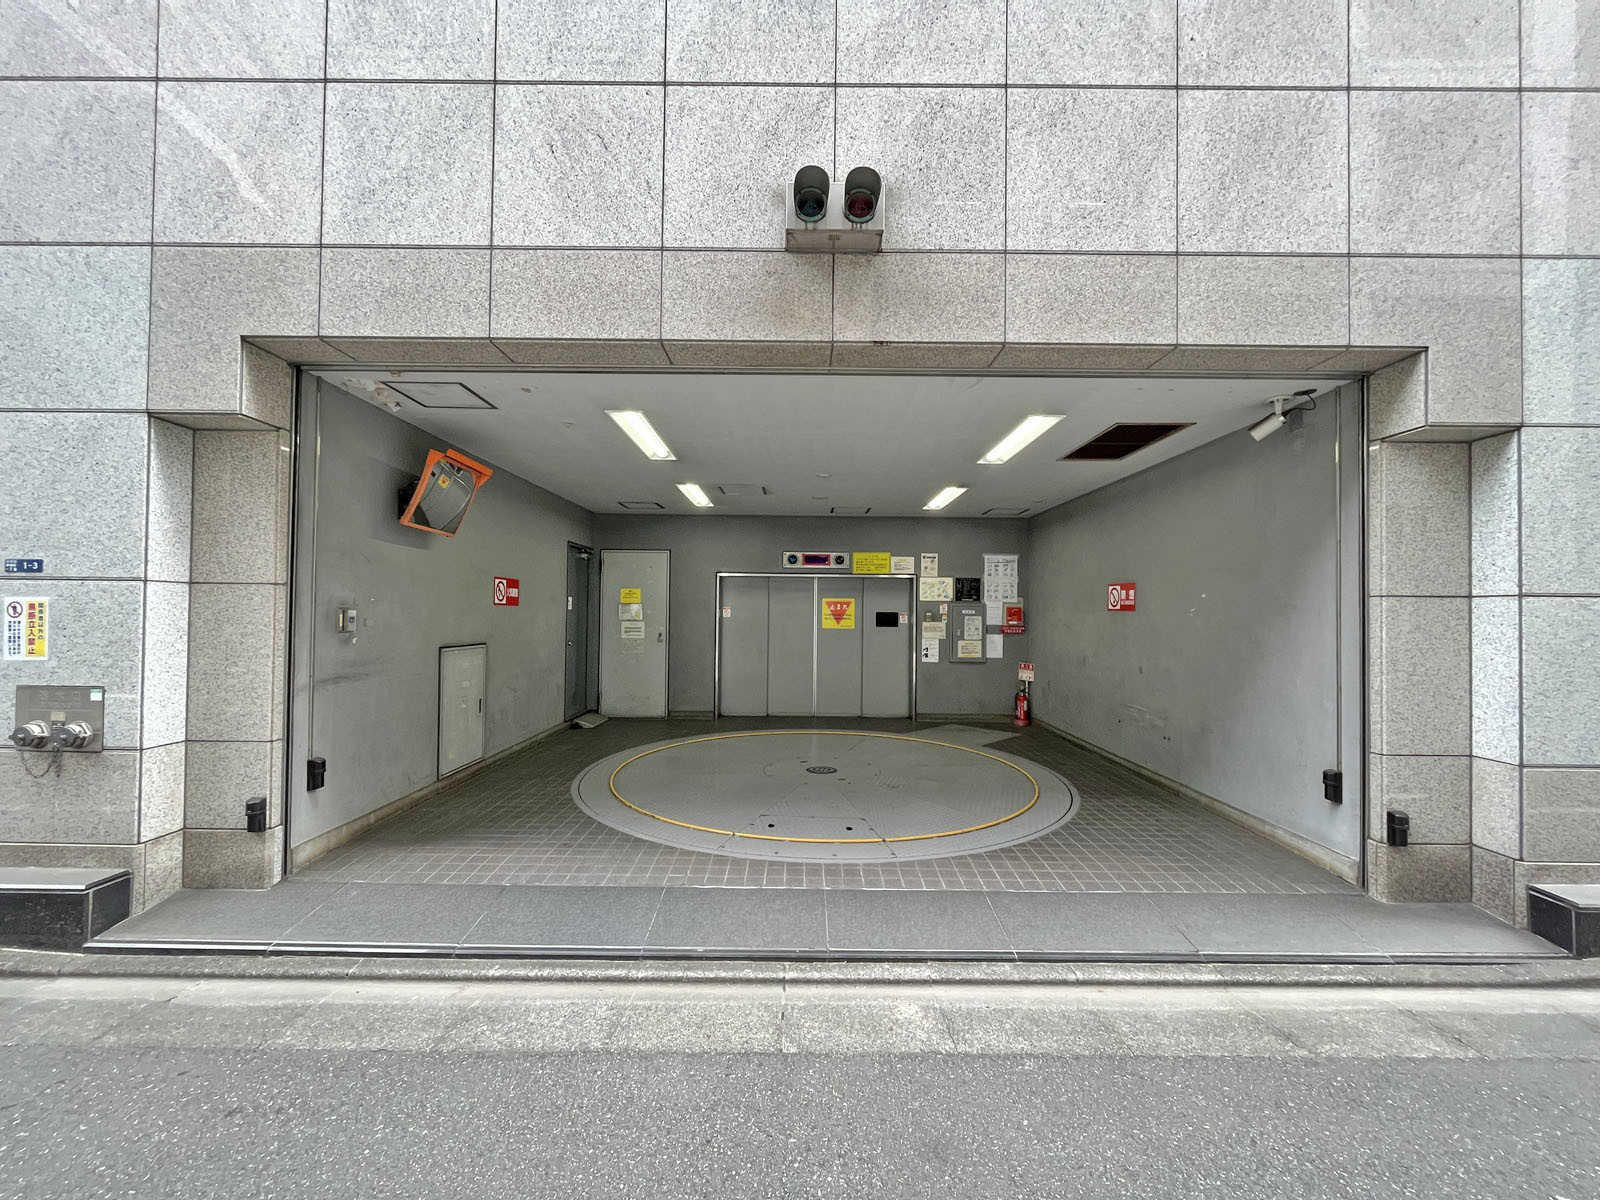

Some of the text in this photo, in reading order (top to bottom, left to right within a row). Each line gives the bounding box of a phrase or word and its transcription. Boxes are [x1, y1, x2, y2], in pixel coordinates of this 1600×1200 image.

[23, 561, 38, 570] 1-3
[28, 602, 36, 655] 無断立入禁止
